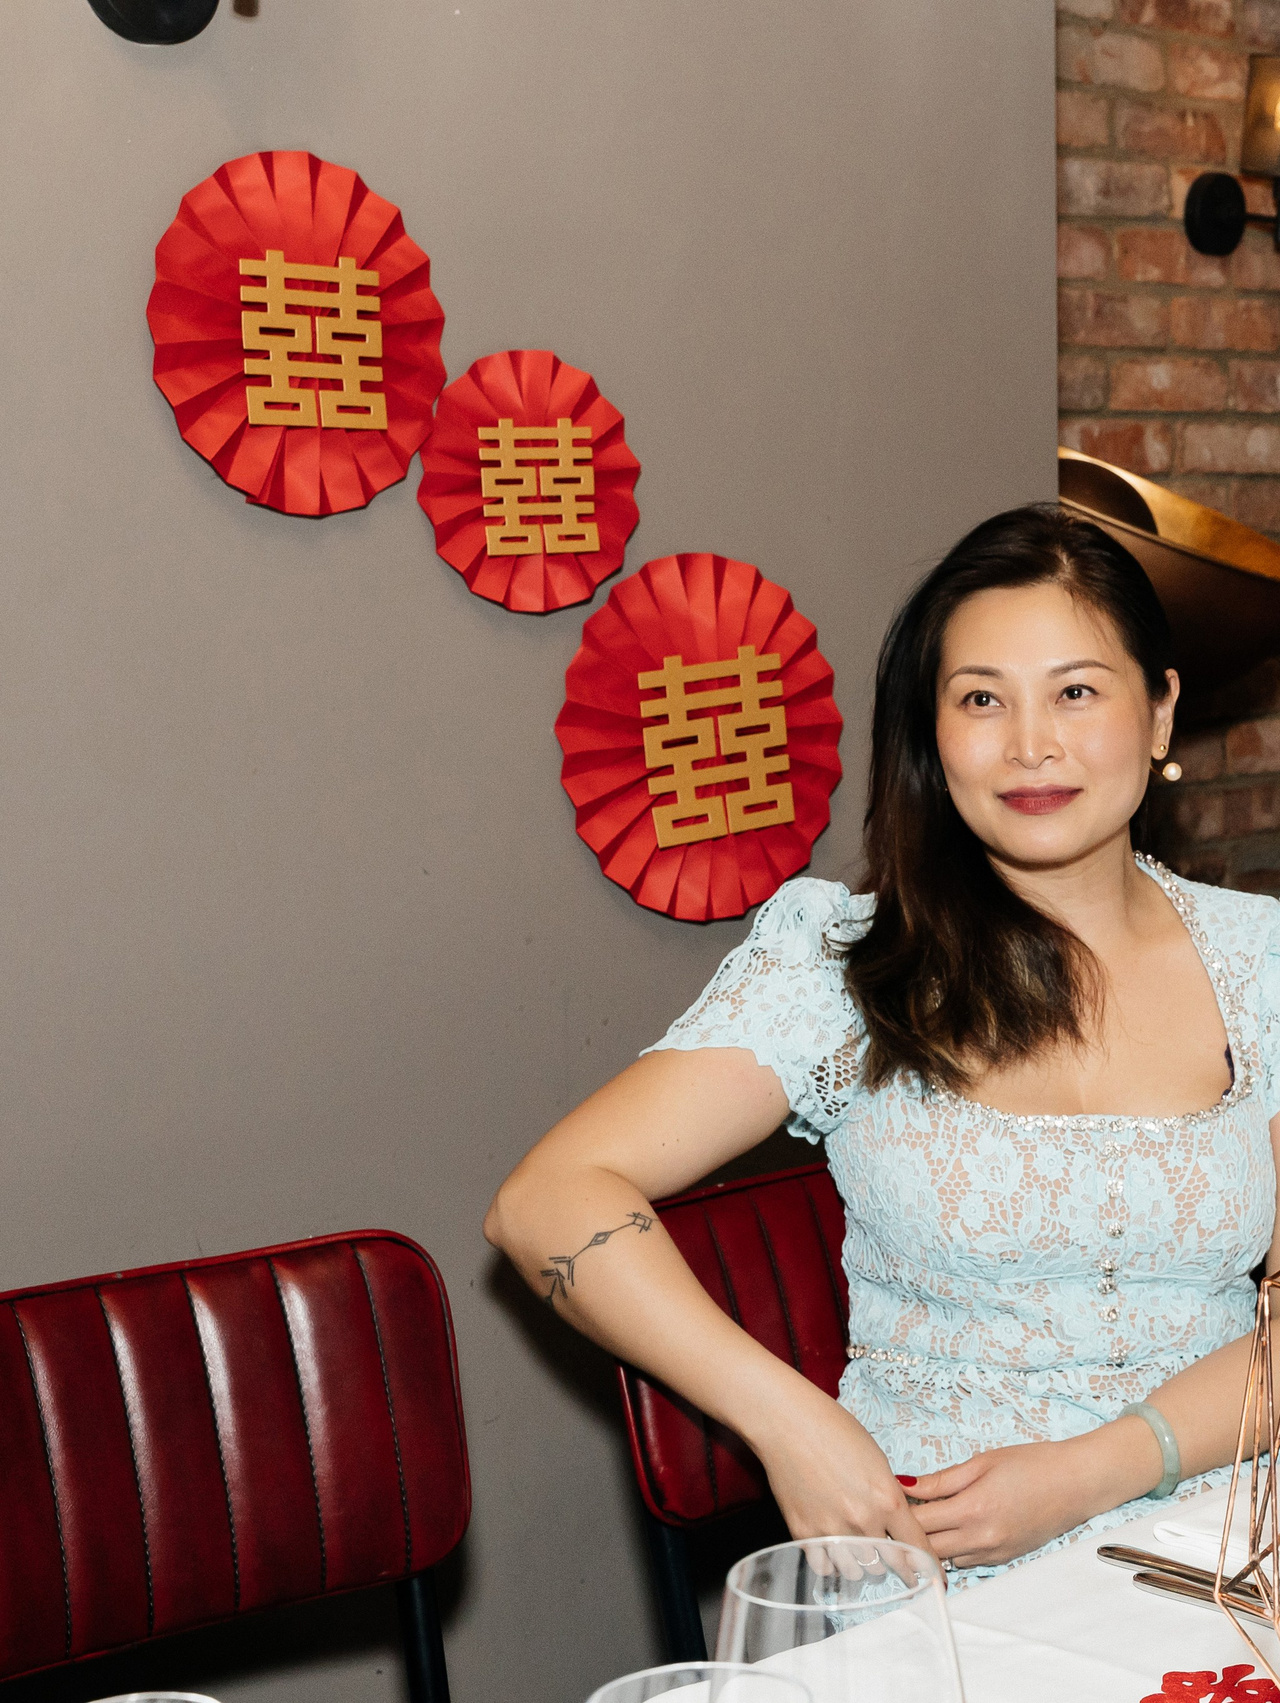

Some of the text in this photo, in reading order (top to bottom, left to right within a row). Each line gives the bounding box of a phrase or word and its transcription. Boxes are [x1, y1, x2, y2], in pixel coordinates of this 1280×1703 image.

[239, 249, 388, 431] 囍
[477, 418, 601, 556] 囍
[637, 645, 796, 849] 囍
